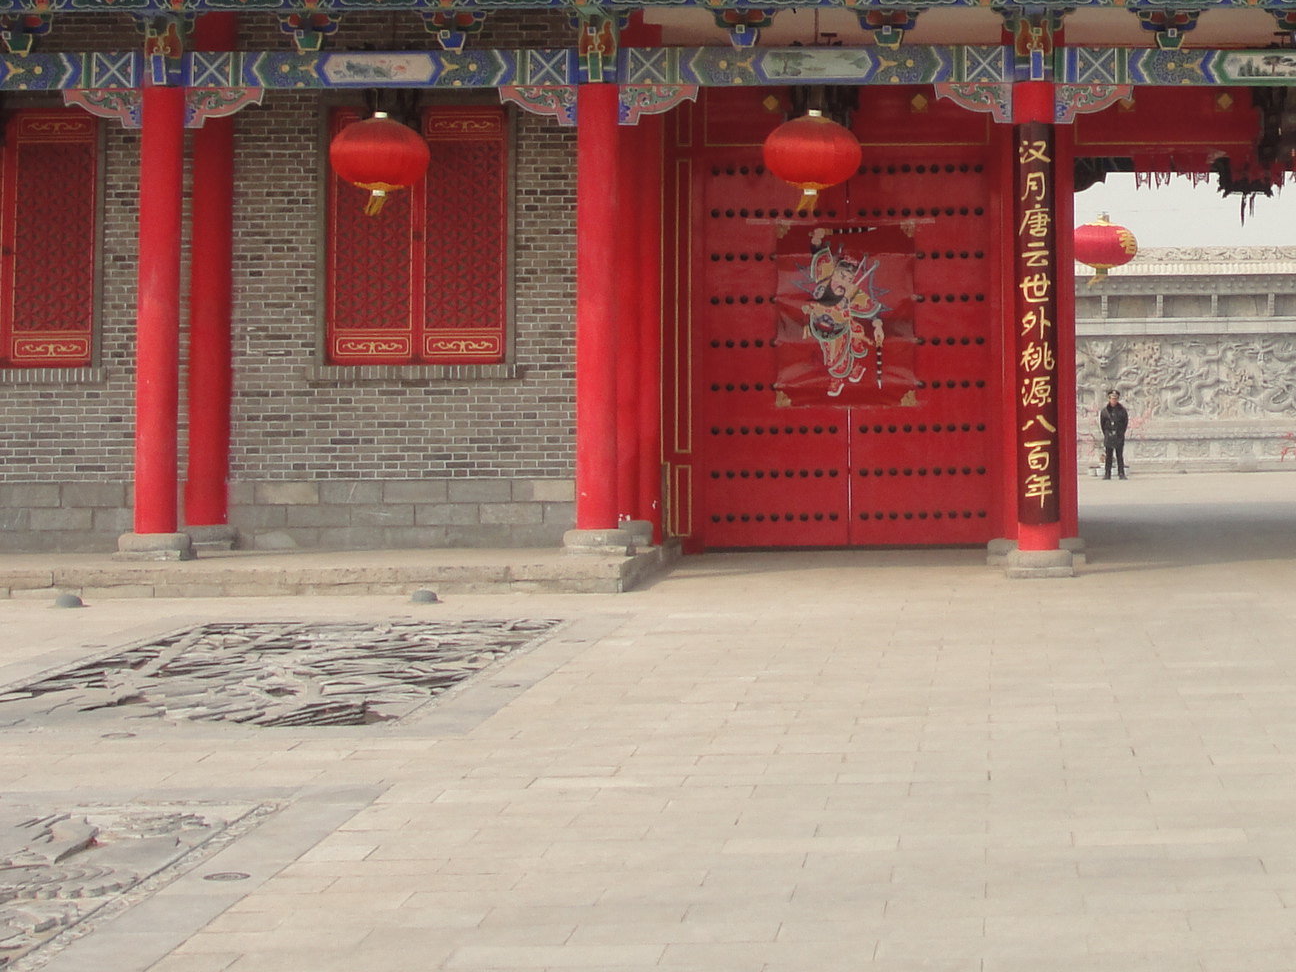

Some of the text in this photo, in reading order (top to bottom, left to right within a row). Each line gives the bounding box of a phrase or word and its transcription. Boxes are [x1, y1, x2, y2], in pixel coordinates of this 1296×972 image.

[1019, 140, 1056, 508] 汉月唐云世外桃源八百年
